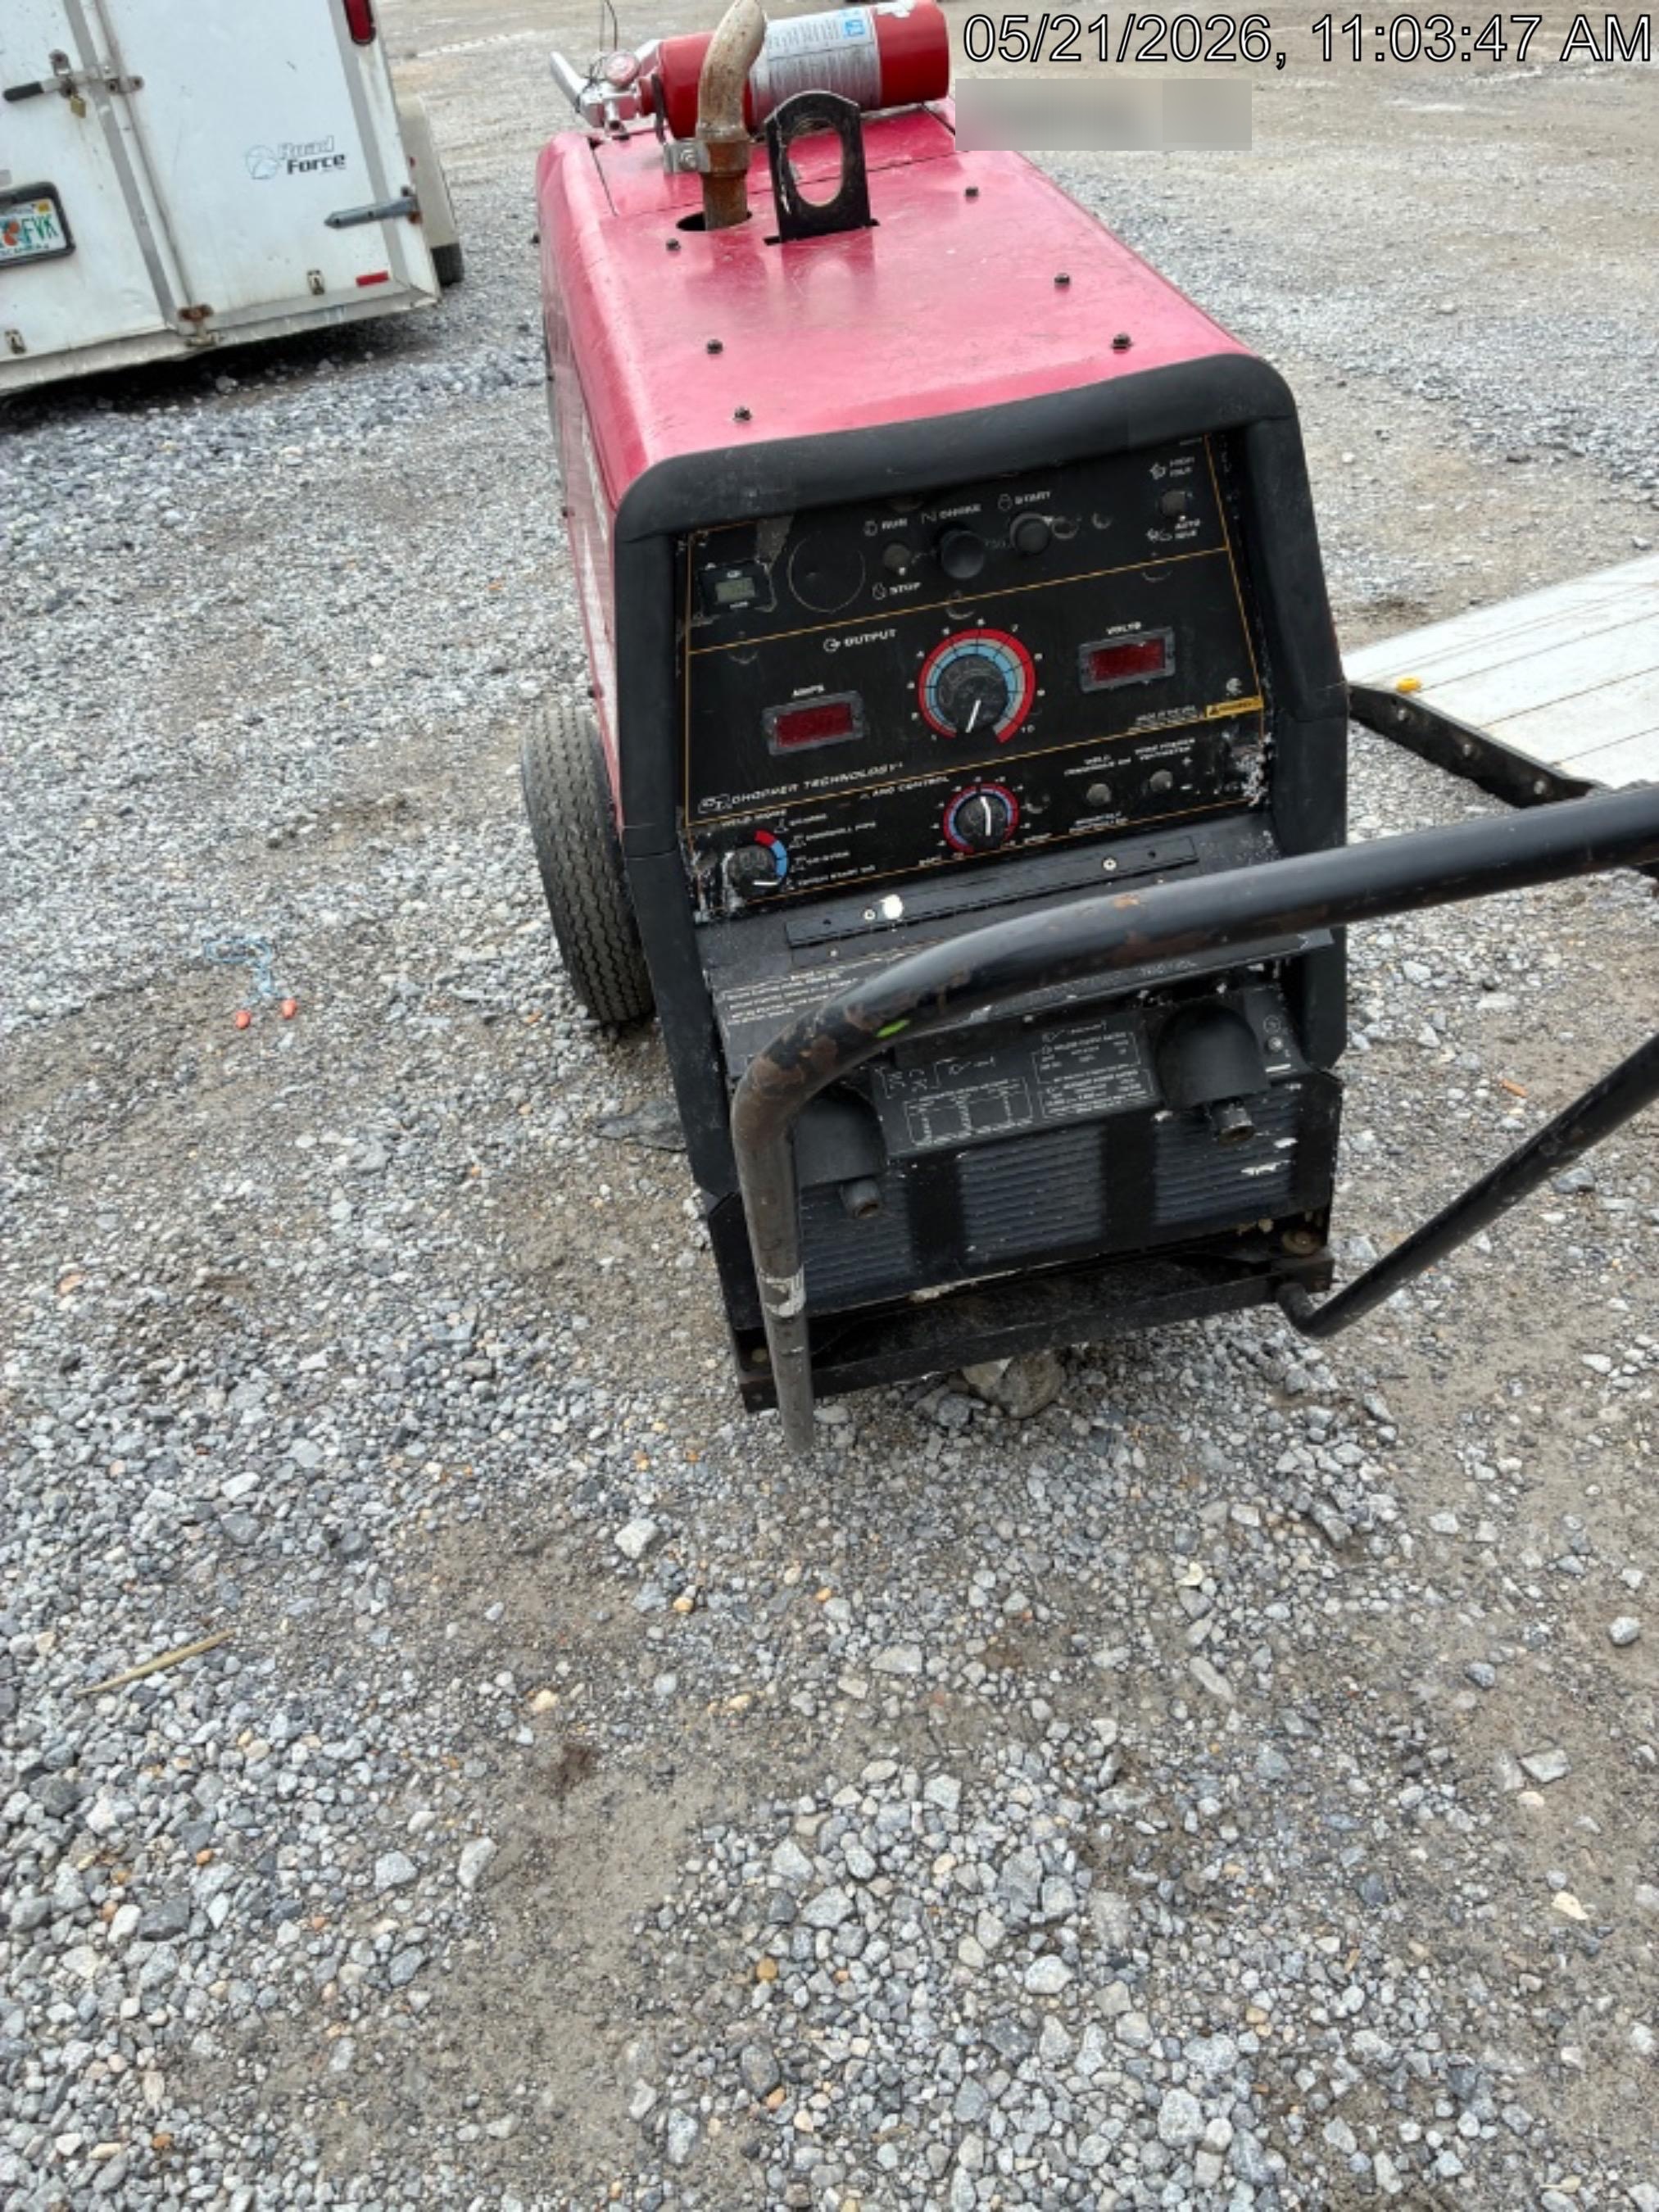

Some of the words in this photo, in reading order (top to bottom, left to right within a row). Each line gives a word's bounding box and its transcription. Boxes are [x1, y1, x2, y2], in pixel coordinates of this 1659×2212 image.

[287, 153, 347, 175] Force
[881, 518, 909, 531] RUN
[889, 581, 922, 596] STOP
[1106, 621, 1142, 636] VOLTS
[844, 628, 897, 646] OUTPUT
[732, 783, 799, 805] CHOPPER
[803, 764, 897, 790] TECHNOLOGY
